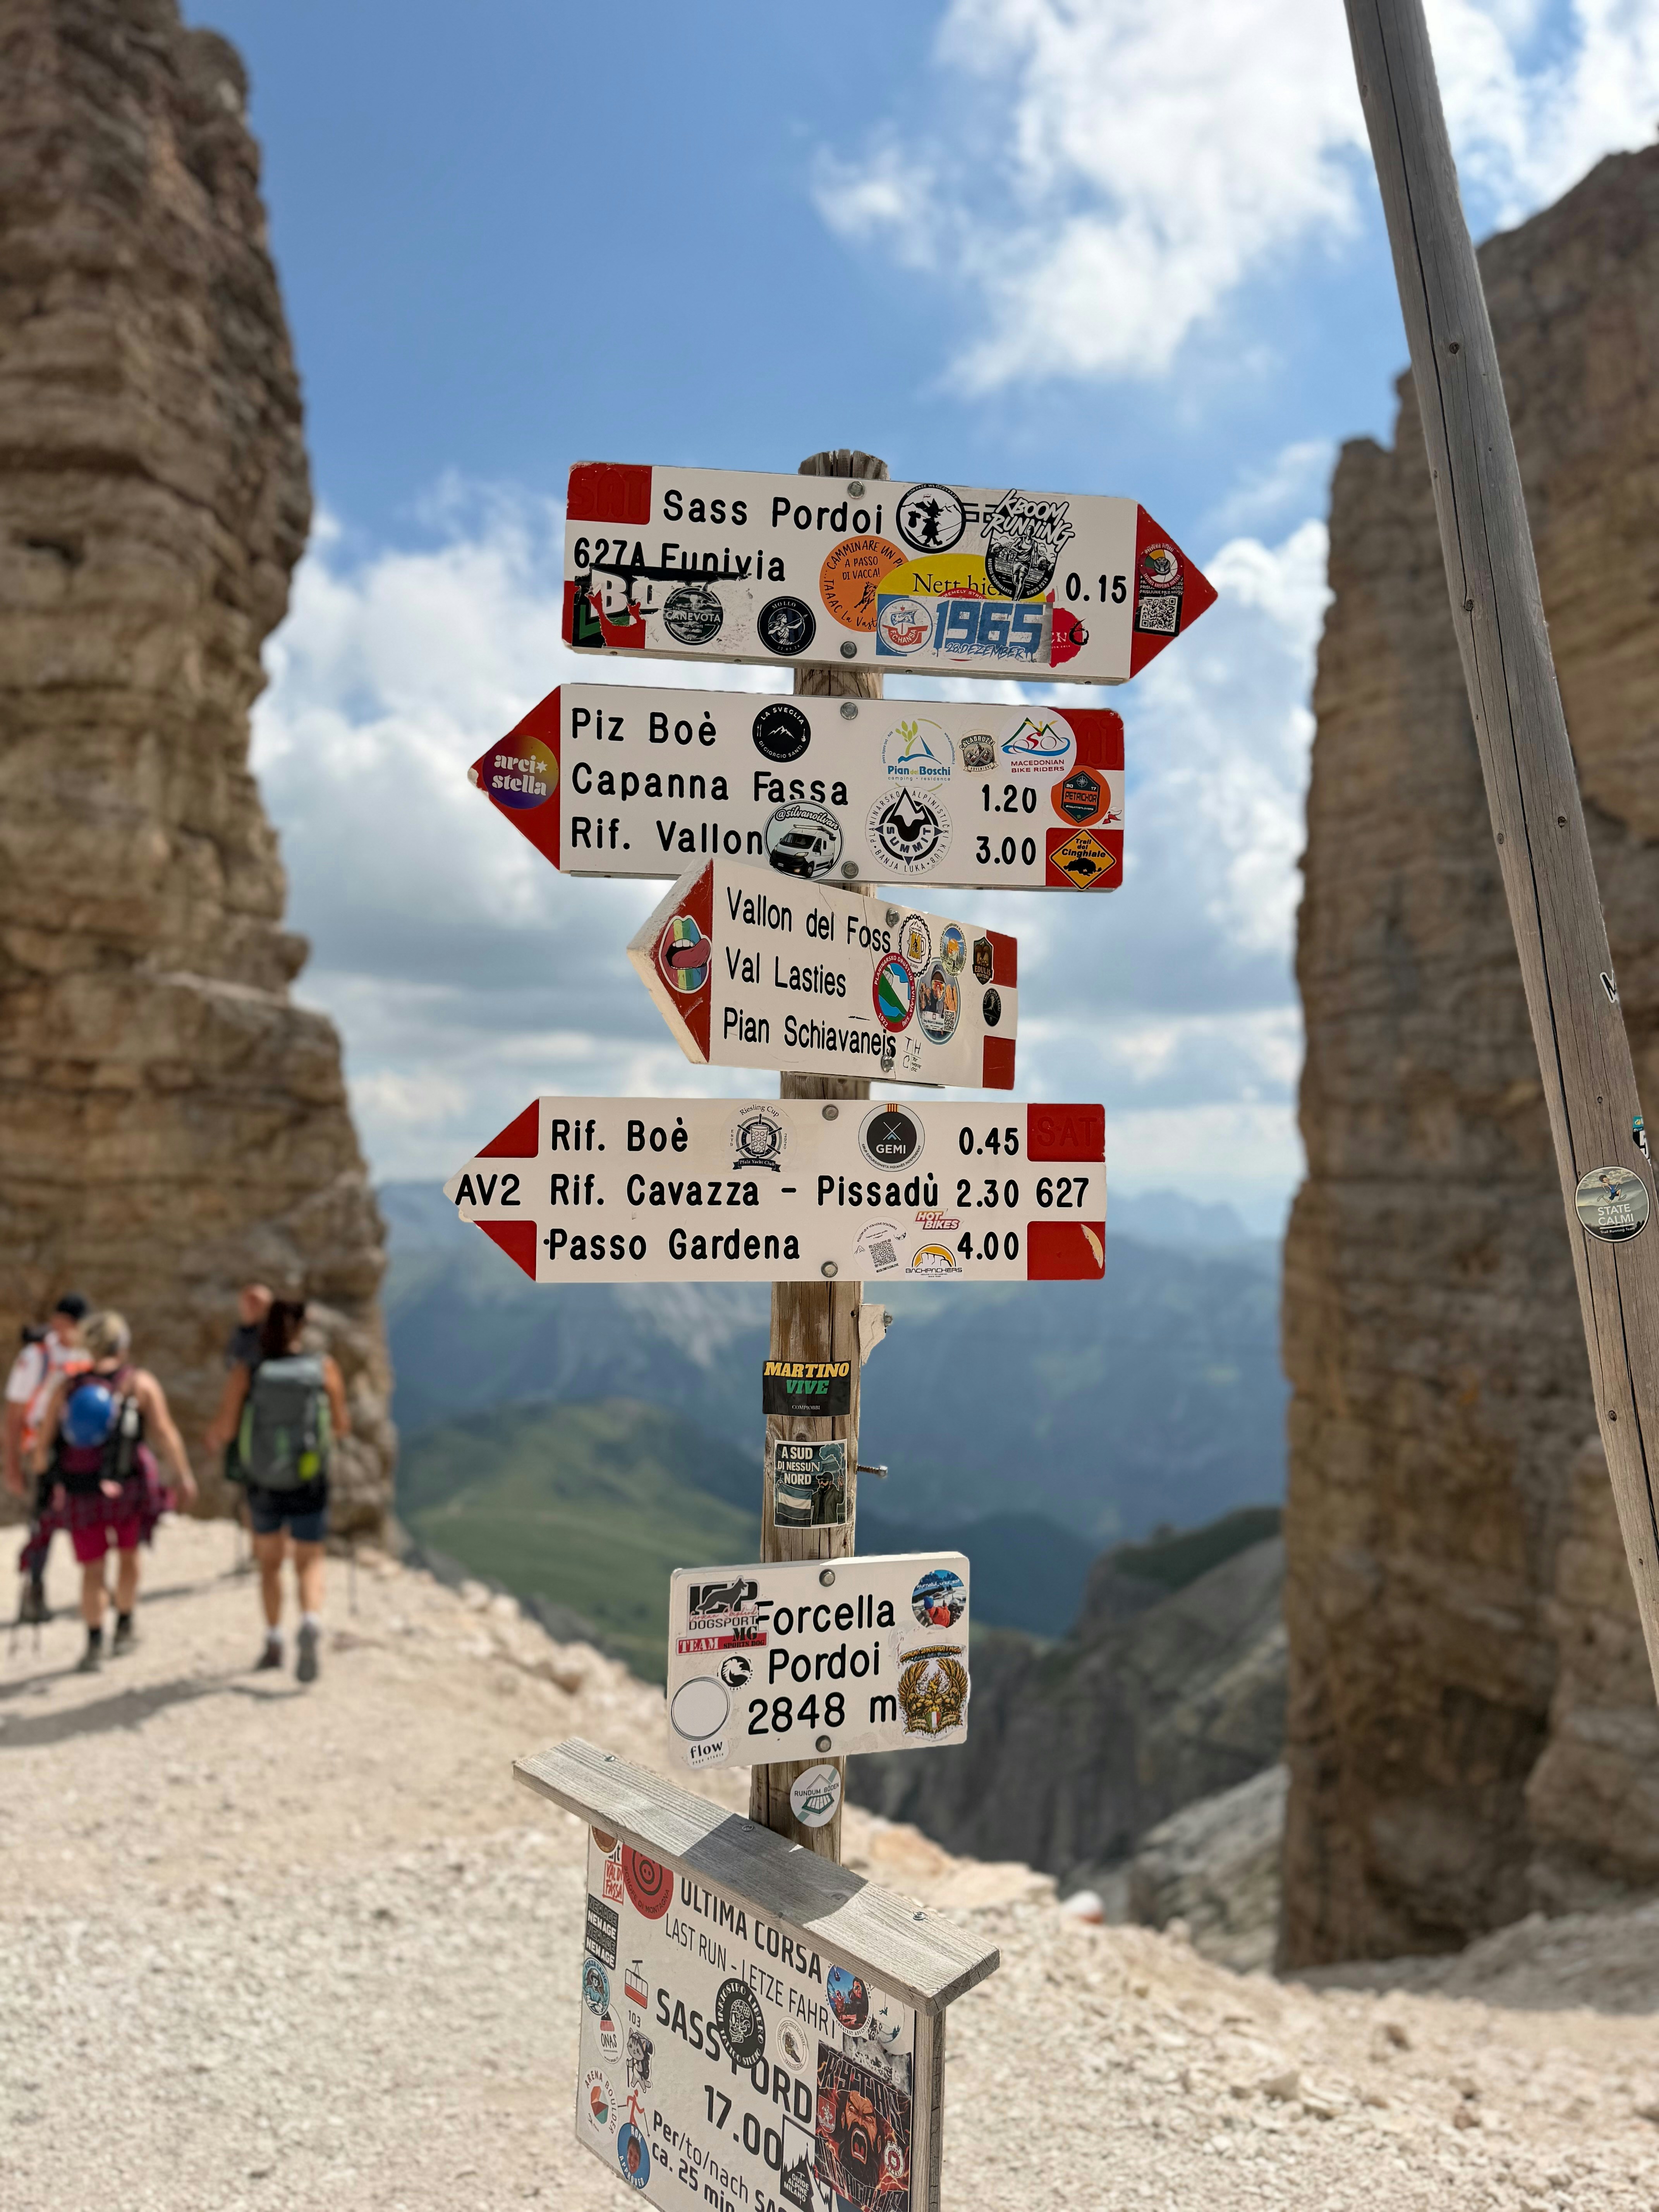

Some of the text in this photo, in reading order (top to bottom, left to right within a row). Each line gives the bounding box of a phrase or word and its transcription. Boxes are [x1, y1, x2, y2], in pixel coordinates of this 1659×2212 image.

[663, 490, 882, 534] Sass Pordoi
[993, 489, 1069, 526] KBOOM
[574, 538, 644, 568] 627A
[662, 543, 785, 582] Funivia
[827, 540, 896, 569] CAMMINARE UN
[845, 556, 878, 568] A PASSO
[842, 568, 880, 580] DI VACCA!
[913, 572, 965, 594] Nett
[1066, 572, 1127, 603] 0.15
[772, 601, 796, 609] MOLLO
[665, 611, 721, 622] CANEVOTA
[933, 600, 1044, 654] 1965
[572, 708, 716, 746] Piz Boè
[761, 707, 804, 725] LA SVEGLIA
[763, 747, 787, 758] GIORGIO
[788, 745, 803, 757] SANTI
[495, 755, 537, 774] arci
[888, 766, 950, 775] Pian Boschi
[492, 774, 547, 796] stella
[572, 762, 848, 805] Capanna Fassa
[981, 784, 1037, 813] 1.20
[1065, 791, 1097, 803] PETRICHOR
[775, 805, 839, 830] @silvanoilvan
[869, 791, 900, 843] PLANINARSKO
[912, 790, 950, 839] ALPINISTIČKI
[572, 816, 763, 855] Rif. Vallon
[887, 826, 931, 853] SUMMIT
[875, 849, 926, 872] BANJA LUKA
[976, 836, 1037, 866] 3.00
[1061, 848, 1106, 859] Cinghiale
[726, 886, 892, 954] Vallon del Foss
[726, 946, 847, 998] Val Lasties
[874, 955, 896, 985] PLANINARSKO
[897, 957, 913, 981] DRUŠTVO
[975, 965, 991, 976] EDULIS
[878, 1013, 888, 1028] 1922
[724, 1007, 897, 1060] Pian Schiavaneis
[740, 1104, 779, 1117] Riesling Cup
[552, 1116, 1099, 1156] Rif. Boè 0.45 SAT
[876, 1144, 906, 1154] GEMI
[455, 1172, 1089, 1208] AV2 Rif. Cavazza Pissadù 2.30 627
[916, 1212, 943, 1221] HOT
[1598, 1204, 1631, 1216] STATE
[1598, 1214, 1634, 1226] CALMI
[924, 1220, 959, 1230] BIKES
[550, 1228, 1019, 1261] Passo Gardena 4.00
[764, 1362, 850, 1378] MARTINO
[786, 1379, 830, 1394] VIVE
[782, 1446, 813, 1460] A SUD
[778, 1461, 820, 1472] DI NESSUN
[784, 1473, 812, 1485] NORD
[689, 1616, 757, 1630] DOGSPORT
[756, 1594, 895, 1635] Forcella
[680, 1638, 719, 1652] TEAM
[733, 1626, 757, 1642] MG
[769, 1642, 879, 1685] Pordoi
[749, 1692, 896, 1735] 2848 m
[690, 1741, 723, 1759] flow
[794, 1782, 839, 1796] RUNDUM BÖDEN
[606, 1863, 616, 1881] VAL
[606, 1879, 622, 1899] FASSA
[624, 1866, 670, 1914] SCROFE DI MONTAGNA
[681, 1877, 822, 1984] ULTIMA CORSA
[666, 1913, 696, 1951] LAST
[699, 1934, 726, 1972] RUN
[742, 1959, 784, 2008] LETZE
[629, 2010, 641, 2028] 103
[718, 1983, 764, 2044] INKIOSTRO LIBERO
[656, 1988, 721, 2062] SASS
[601, 2032, 617, 2049] ONAS
[720, 2028, 742, 2063] TATTOO
[742, 2048, 761, 2066] STUDIO
[585, 2070, 603, 2088] ARENA
[605, 2079, 617, 2134] BOULDER
[704, 2085, 783, 2172] 17.00
[619, 2155, 644, 2187] APPROVED
[652, 2142, 673, 2172] ca.
[678, 2158, 698, 2191] 25
[784, 2183, 806, 2202] MILANO
[788, 2178, 808, 2197] ALPINE
[792, 2173, 810, 2190] GUIDE
